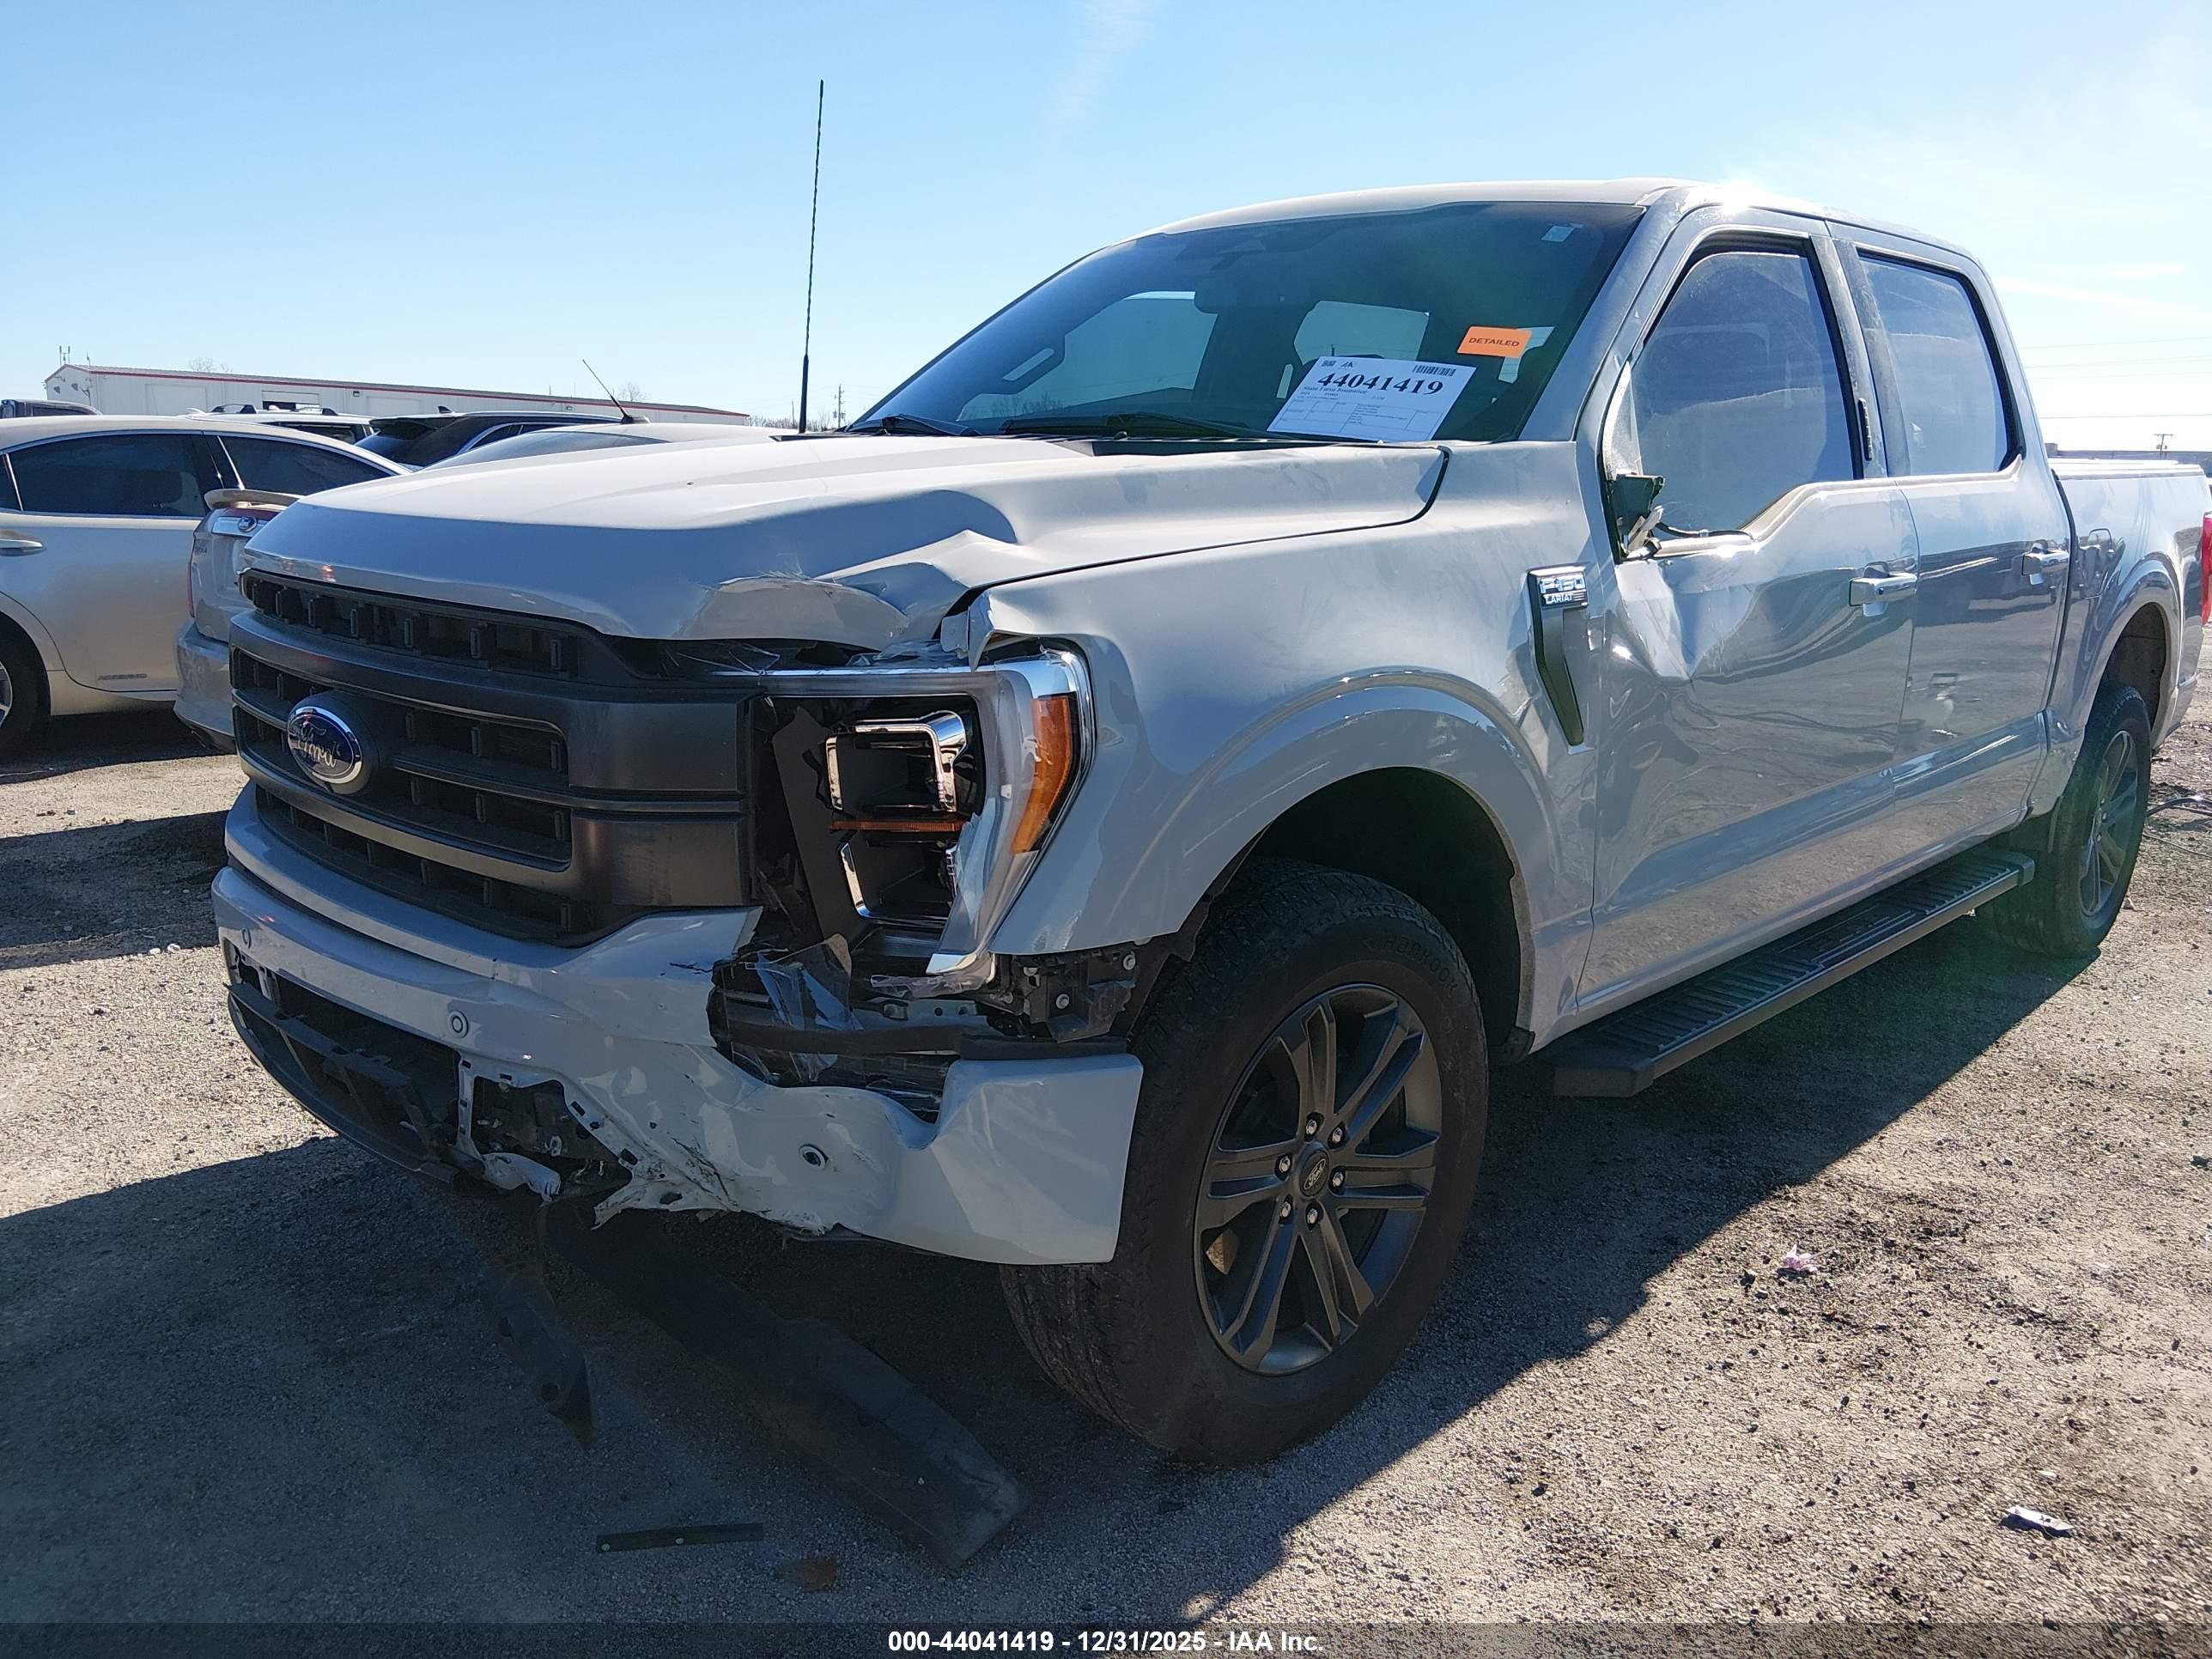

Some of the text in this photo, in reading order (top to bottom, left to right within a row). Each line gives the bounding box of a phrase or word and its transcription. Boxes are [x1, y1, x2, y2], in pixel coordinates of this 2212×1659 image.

[1468, 337, 1520, 347] DETAILED
[1317, 373, 1443, 396] 44041419
[1544, 593, 1574, 605] LARIAT
[289, 720, 341, 769] Ford
